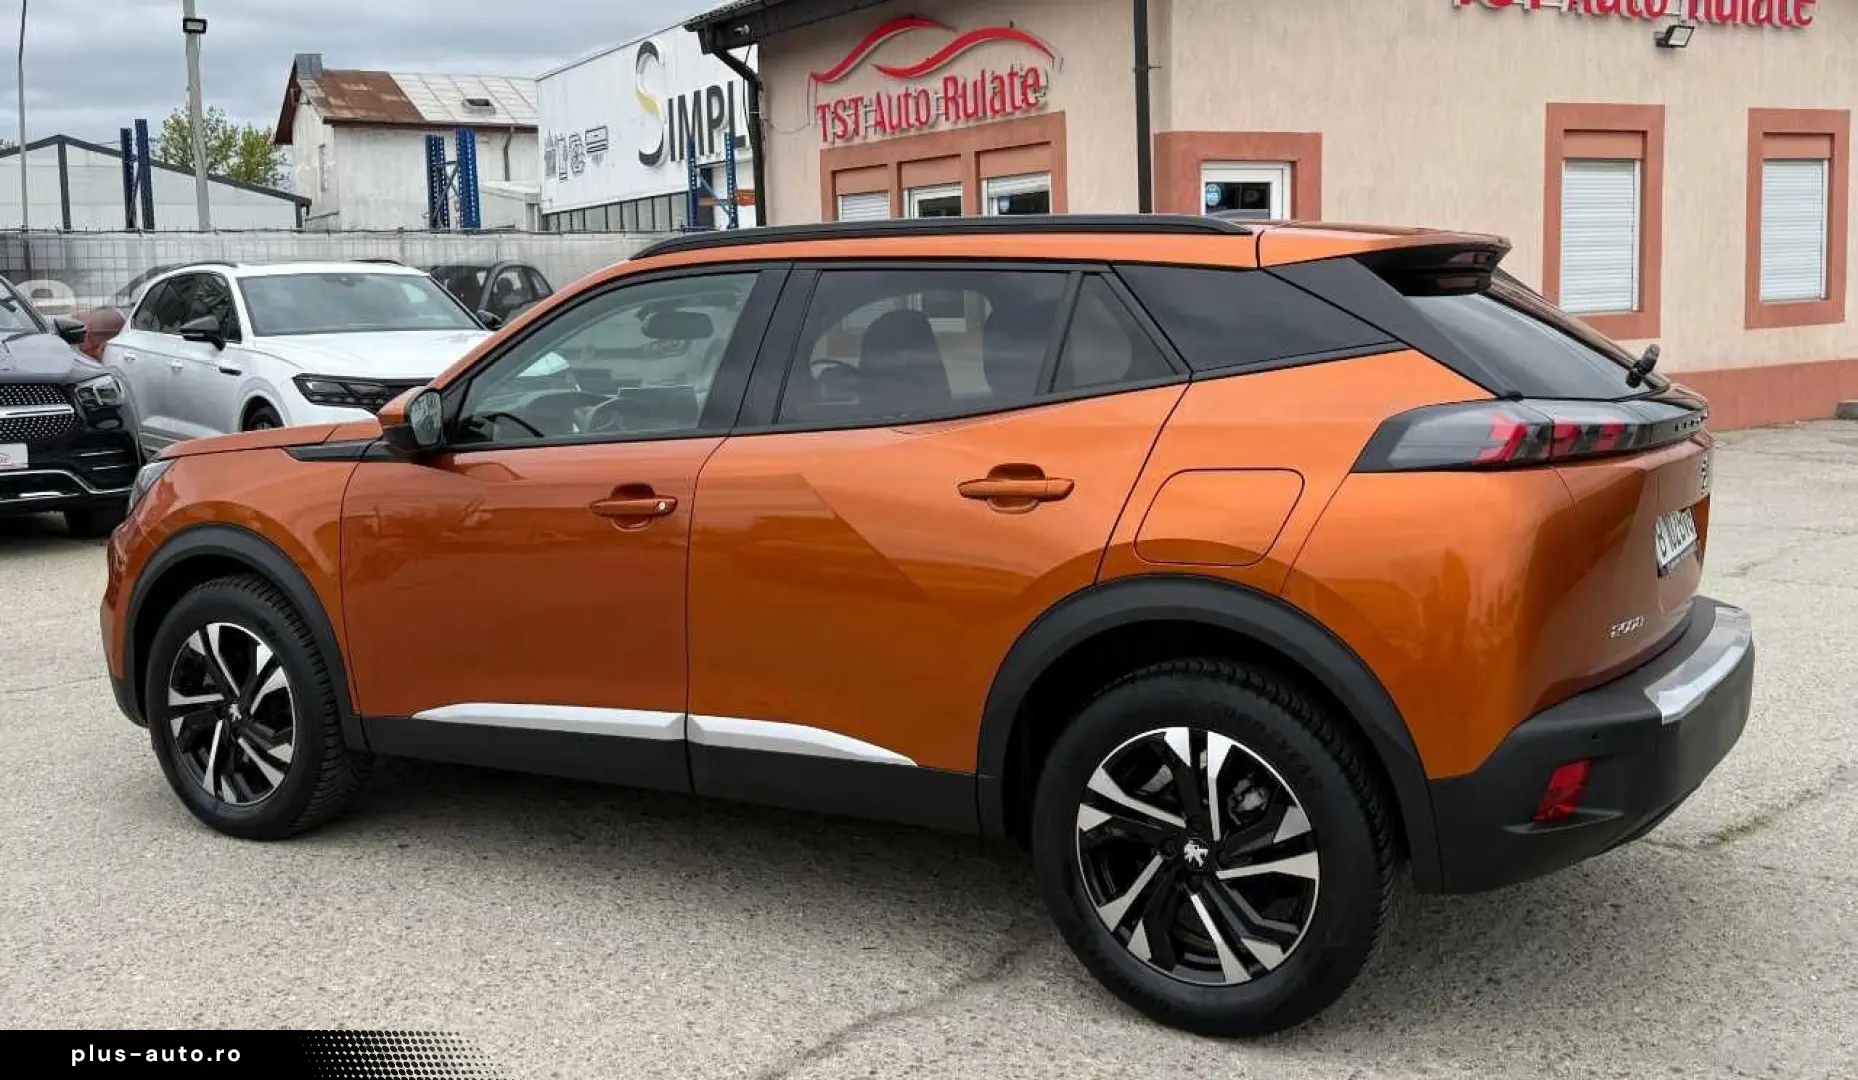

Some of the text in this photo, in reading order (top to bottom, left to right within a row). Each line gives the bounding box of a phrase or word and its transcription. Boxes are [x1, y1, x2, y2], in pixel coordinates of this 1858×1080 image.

[817, 66, 1041, 142] TST Auto Rulate
